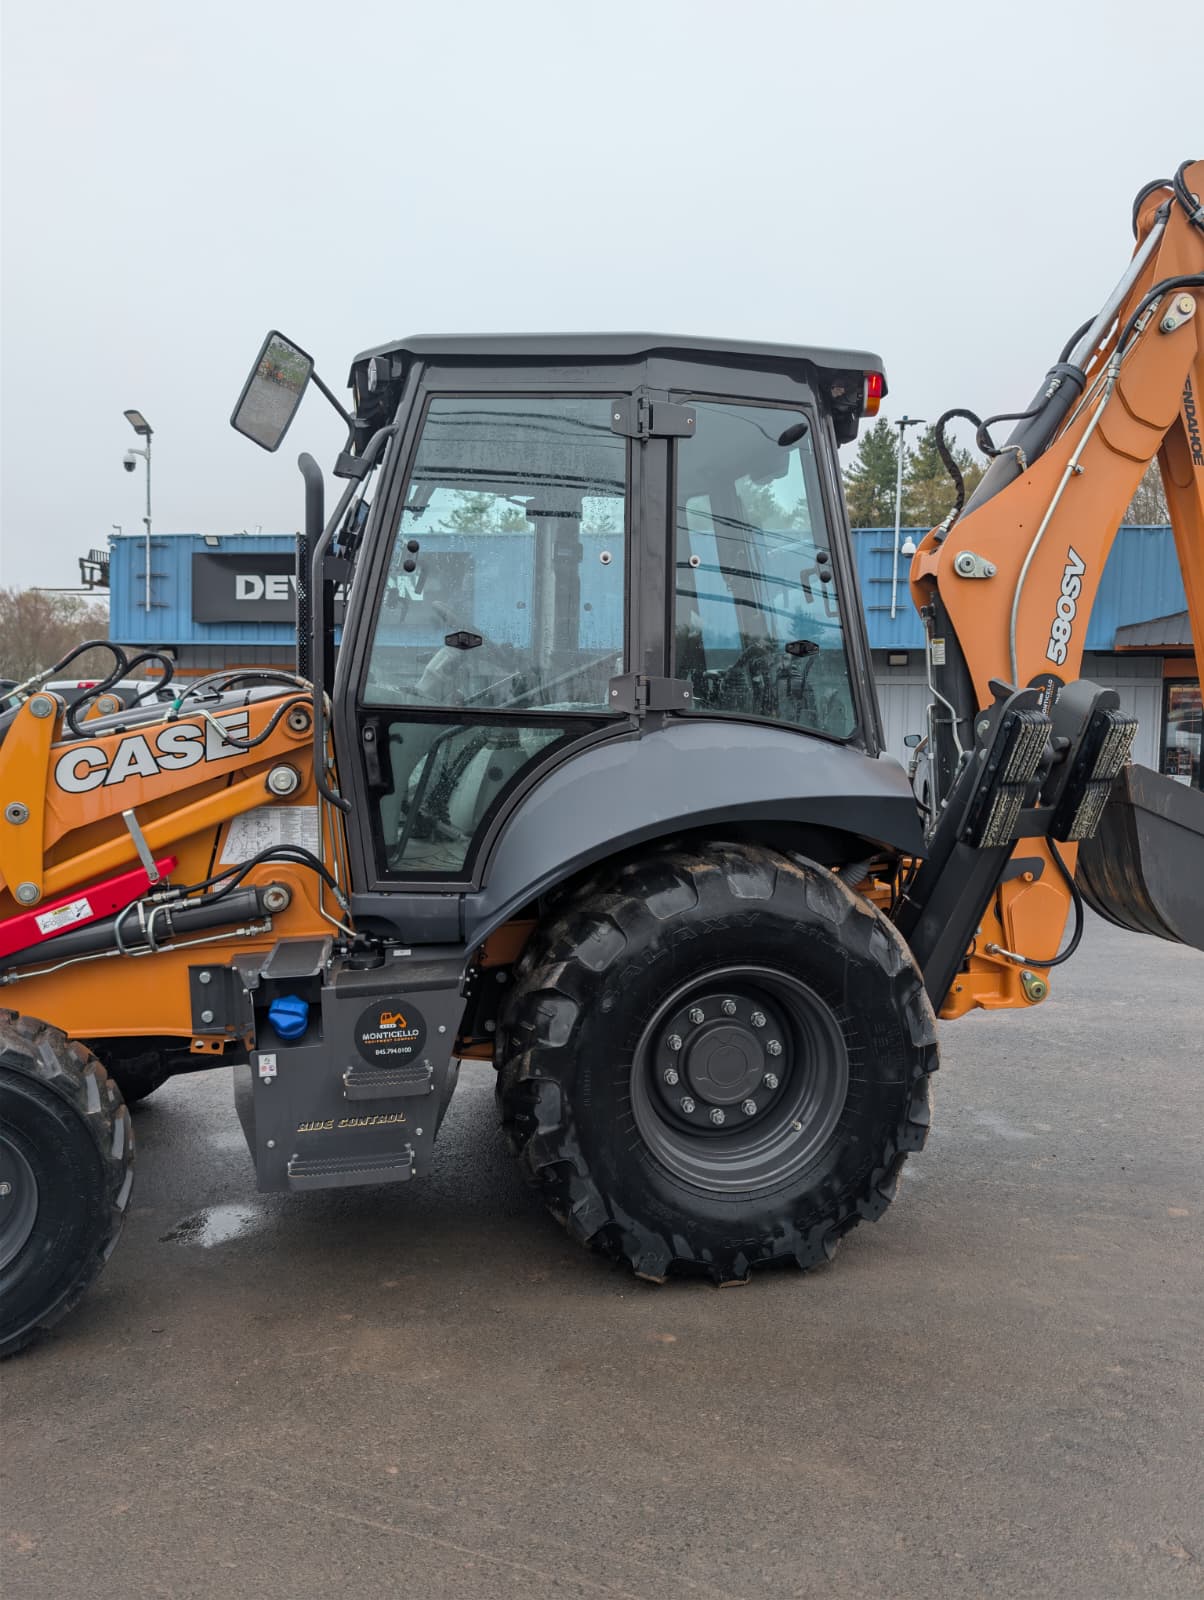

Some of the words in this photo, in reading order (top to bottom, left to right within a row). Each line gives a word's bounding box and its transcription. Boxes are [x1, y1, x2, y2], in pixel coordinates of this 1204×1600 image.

[1045, 544, 1086, 666] 580SV
[54, 710, 250, 794] CASE
[362, 1029, 419, 1040] MONTICELLO
[297, 1119, 335, 1132] RIDE
[337, 1111, 407, 1128] CONTROL
